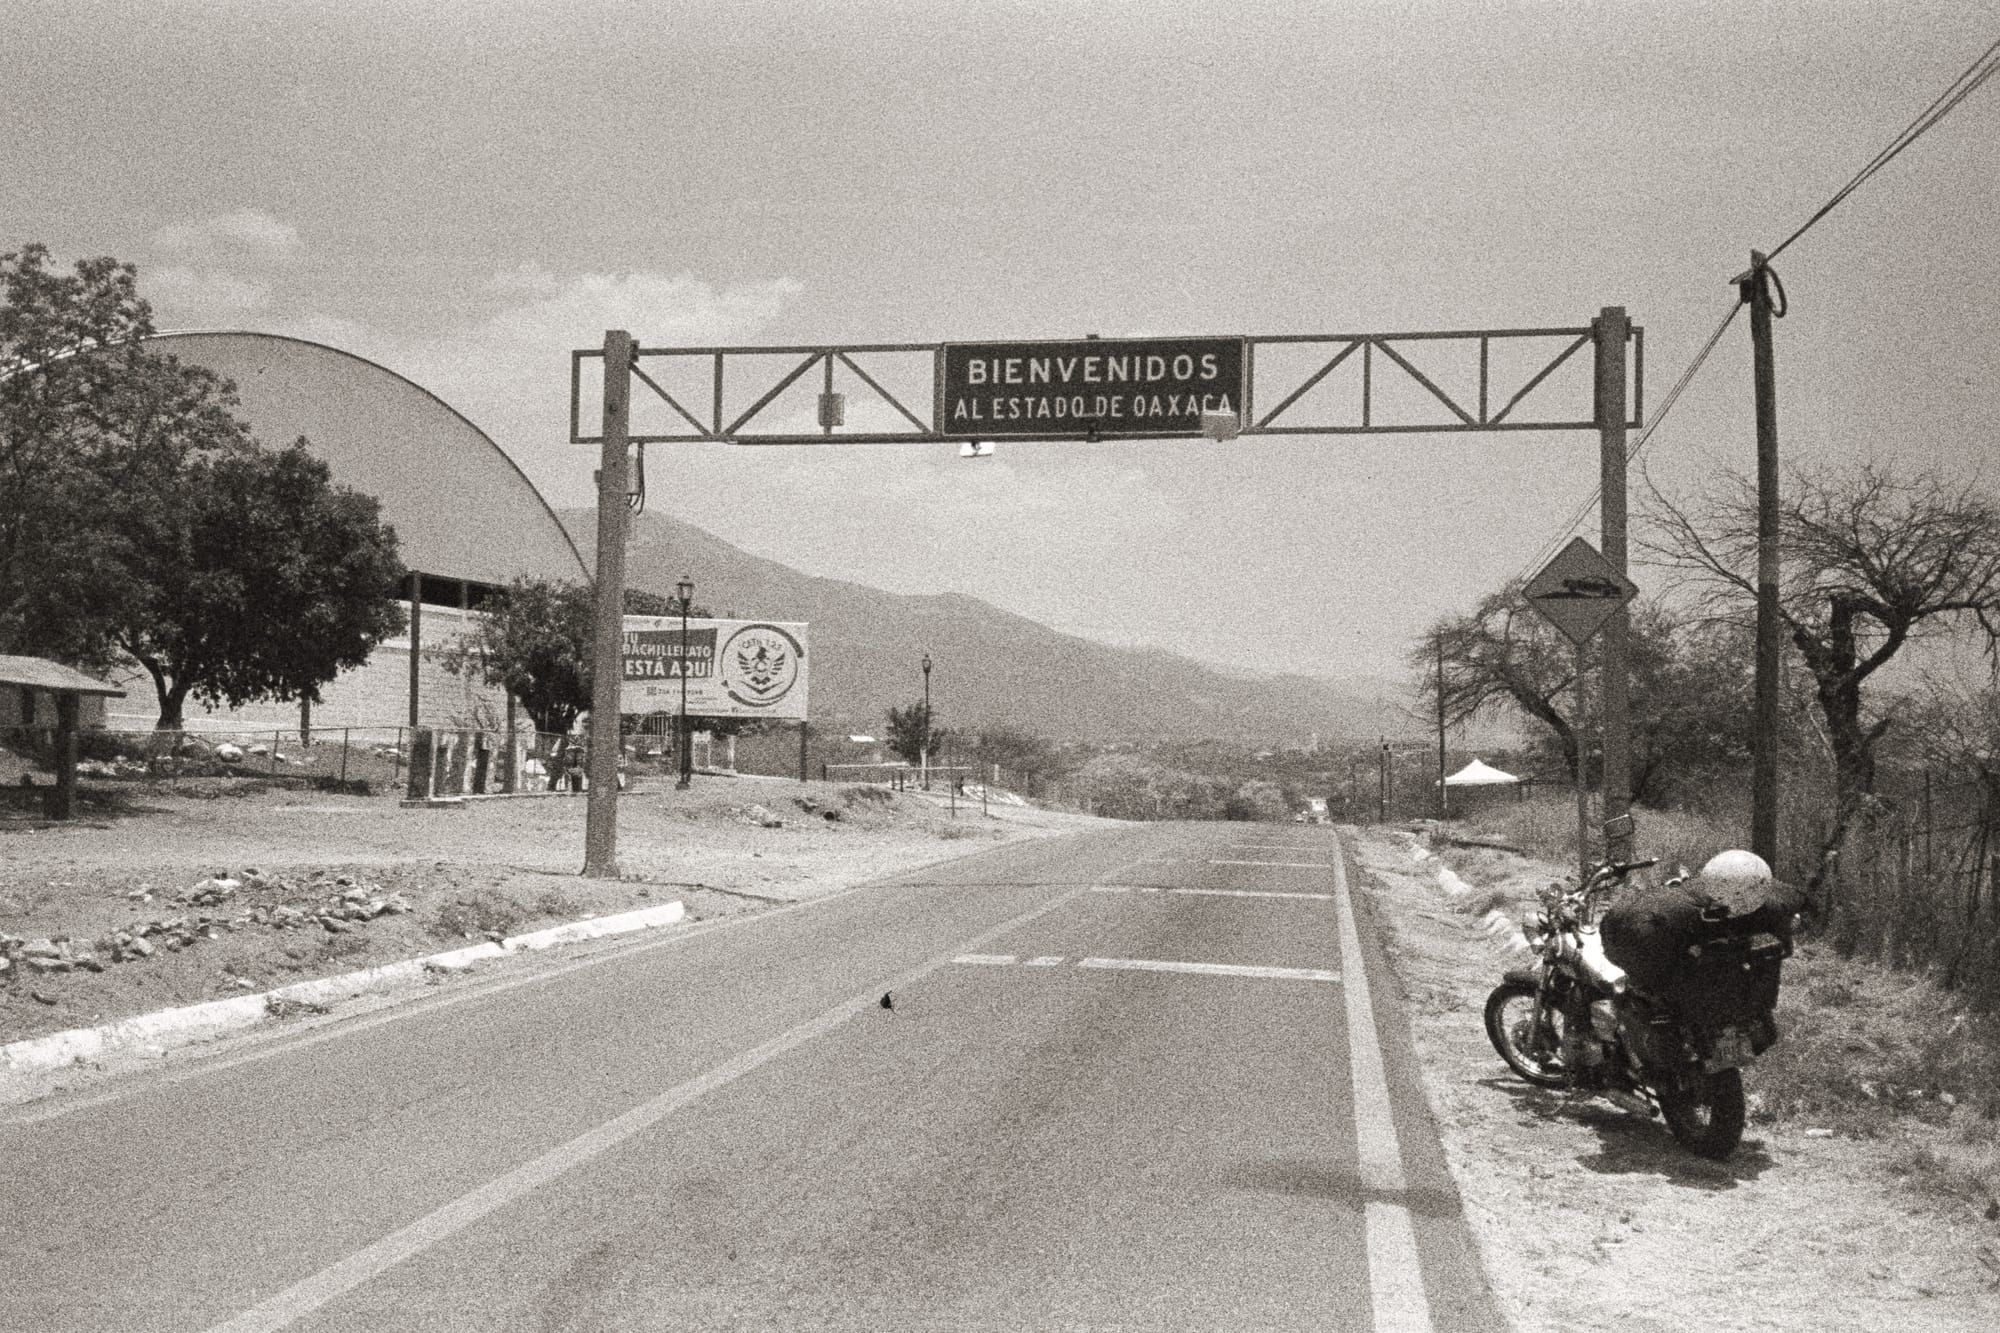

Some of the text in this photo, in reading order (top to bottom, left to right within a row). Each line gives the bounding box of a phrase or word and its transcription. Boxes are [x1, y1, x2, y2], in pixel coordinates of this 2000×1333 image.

[967, 354, 1218, 384] BIENVENIDOS
[953, 393, 1232, 420] AL ESTADO DE OAXACA
[622, 632, 639, 644] TU
[625, 657, 665, 676] ESTÁ
